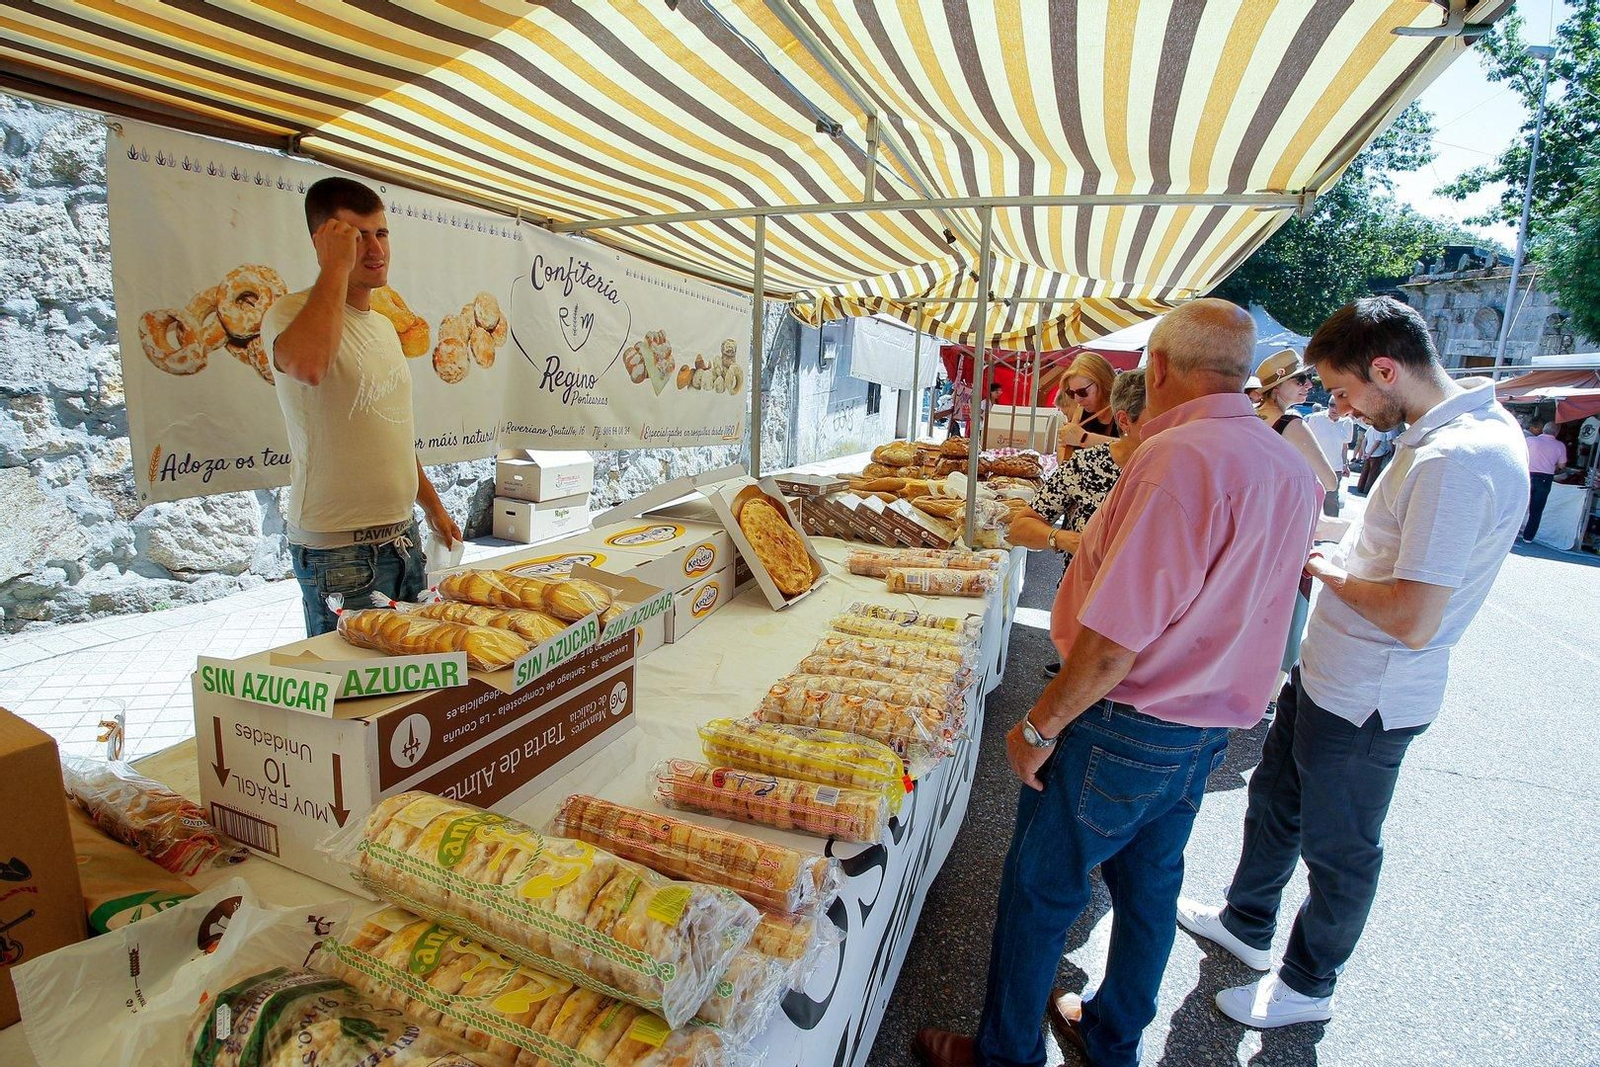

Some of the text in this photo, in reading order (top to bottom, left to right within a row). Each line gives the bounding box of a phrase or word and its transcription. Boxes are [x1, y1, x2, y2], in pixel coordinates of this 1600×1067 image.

[539, 355, 599, 404] Regino
[570, 389, 609, 406] Ponteareas
[428, 432, 458, 448] máis
[462, 428, 496, 444] natural
[506, 421, 548, 435] Reveriano
[160, 447, 292, 484] Adoza os teu
[603, 616, 628, 641] SIN
[627, 592, 673, 628] AZUCAR
[516, 653, 543, 687] SIN
[546, 620, 597, 669] AZUCAR
[202, 665, 329, 713] SIN AZUCAR
[342, 661, 460, 697] AZUCAR
[546, 681, 556, 692] de
[556, 665, 586, 687] Santiago
[498, 686, 545, 715] Compostela
[569, 698, 597, 724] Galicia
[442, 719, 478, 744] Coruña
[479, 712, 491, 725] La
[571, 707, 607, 736] Manxares
[235, 722, 313, 764] Unidades
[264, 757, 291, 789] 10
[440, 721, 566, 800] Tarta de Alme
[232, 773, 288, 810] FRÁGIL
[293, 797, 330, 824] MUY
